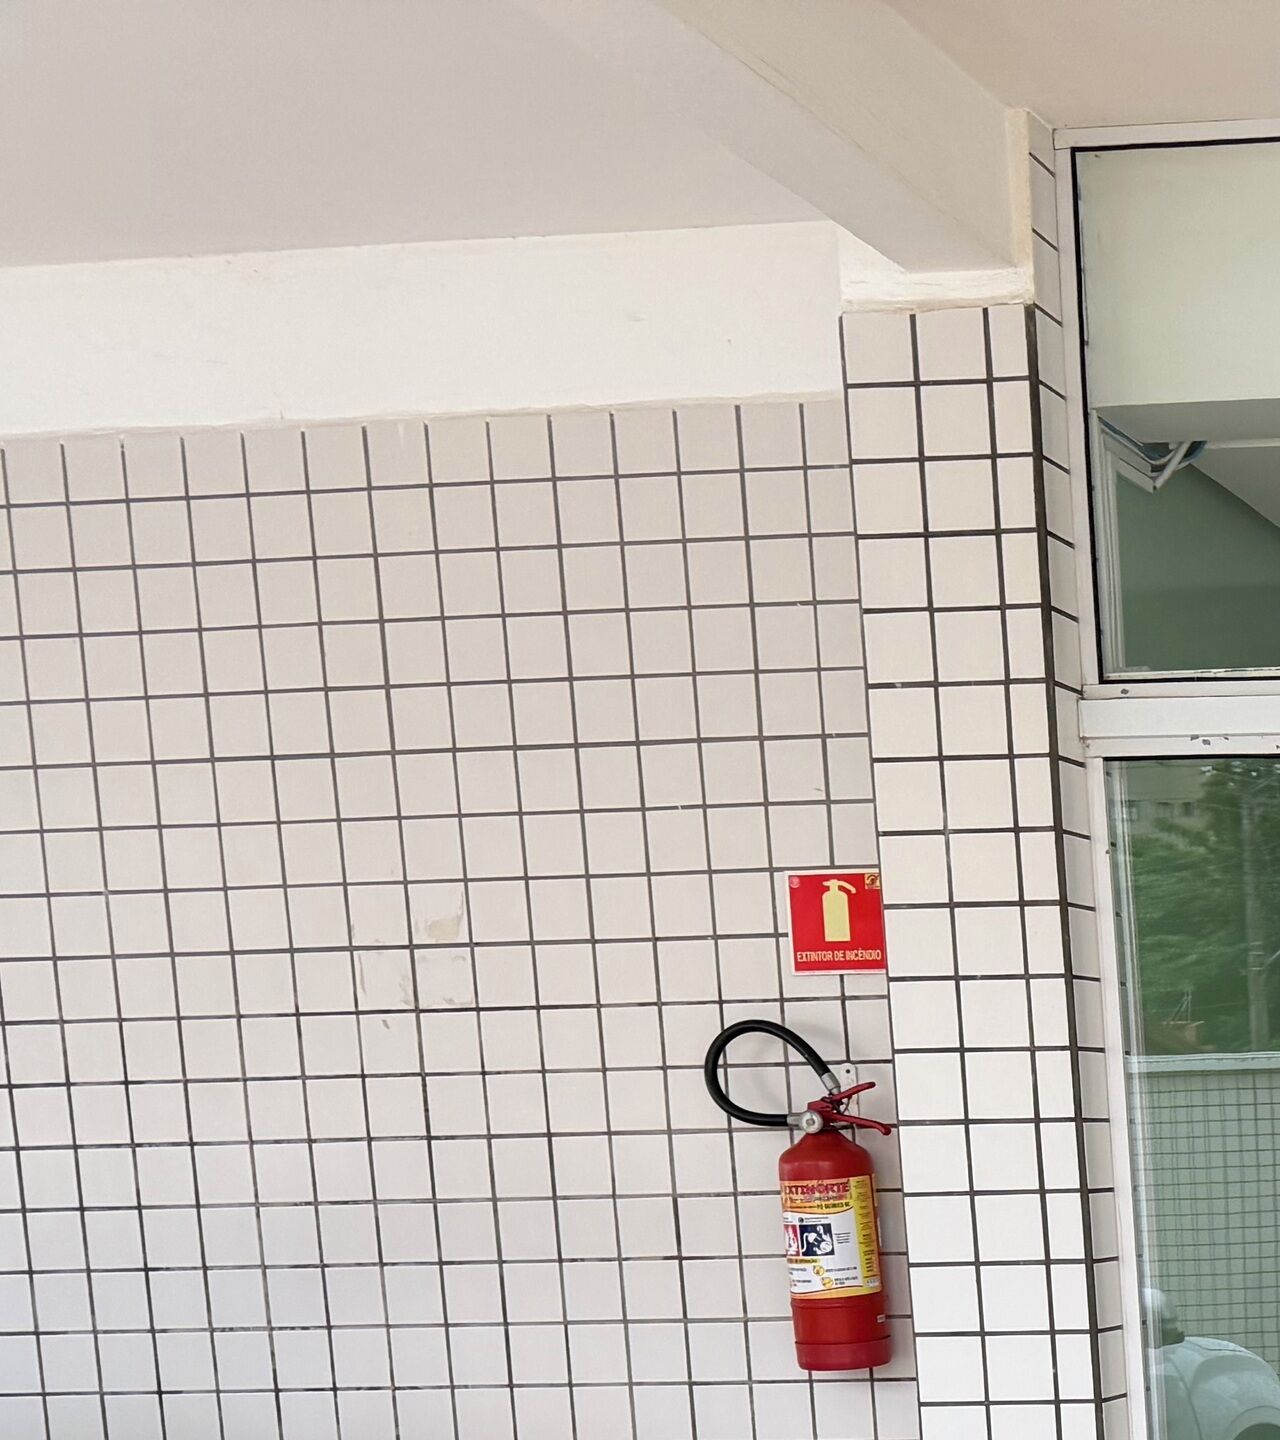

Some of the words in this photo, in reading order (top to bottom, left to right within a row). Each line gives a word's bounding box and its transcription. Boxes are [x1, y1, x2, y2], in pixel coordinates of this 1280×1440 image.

[797, 950, 833, 962] EXTINTOR
[834, 950, 844, 961] DE
[846, 947, 882, 961] INCÊNDIO
